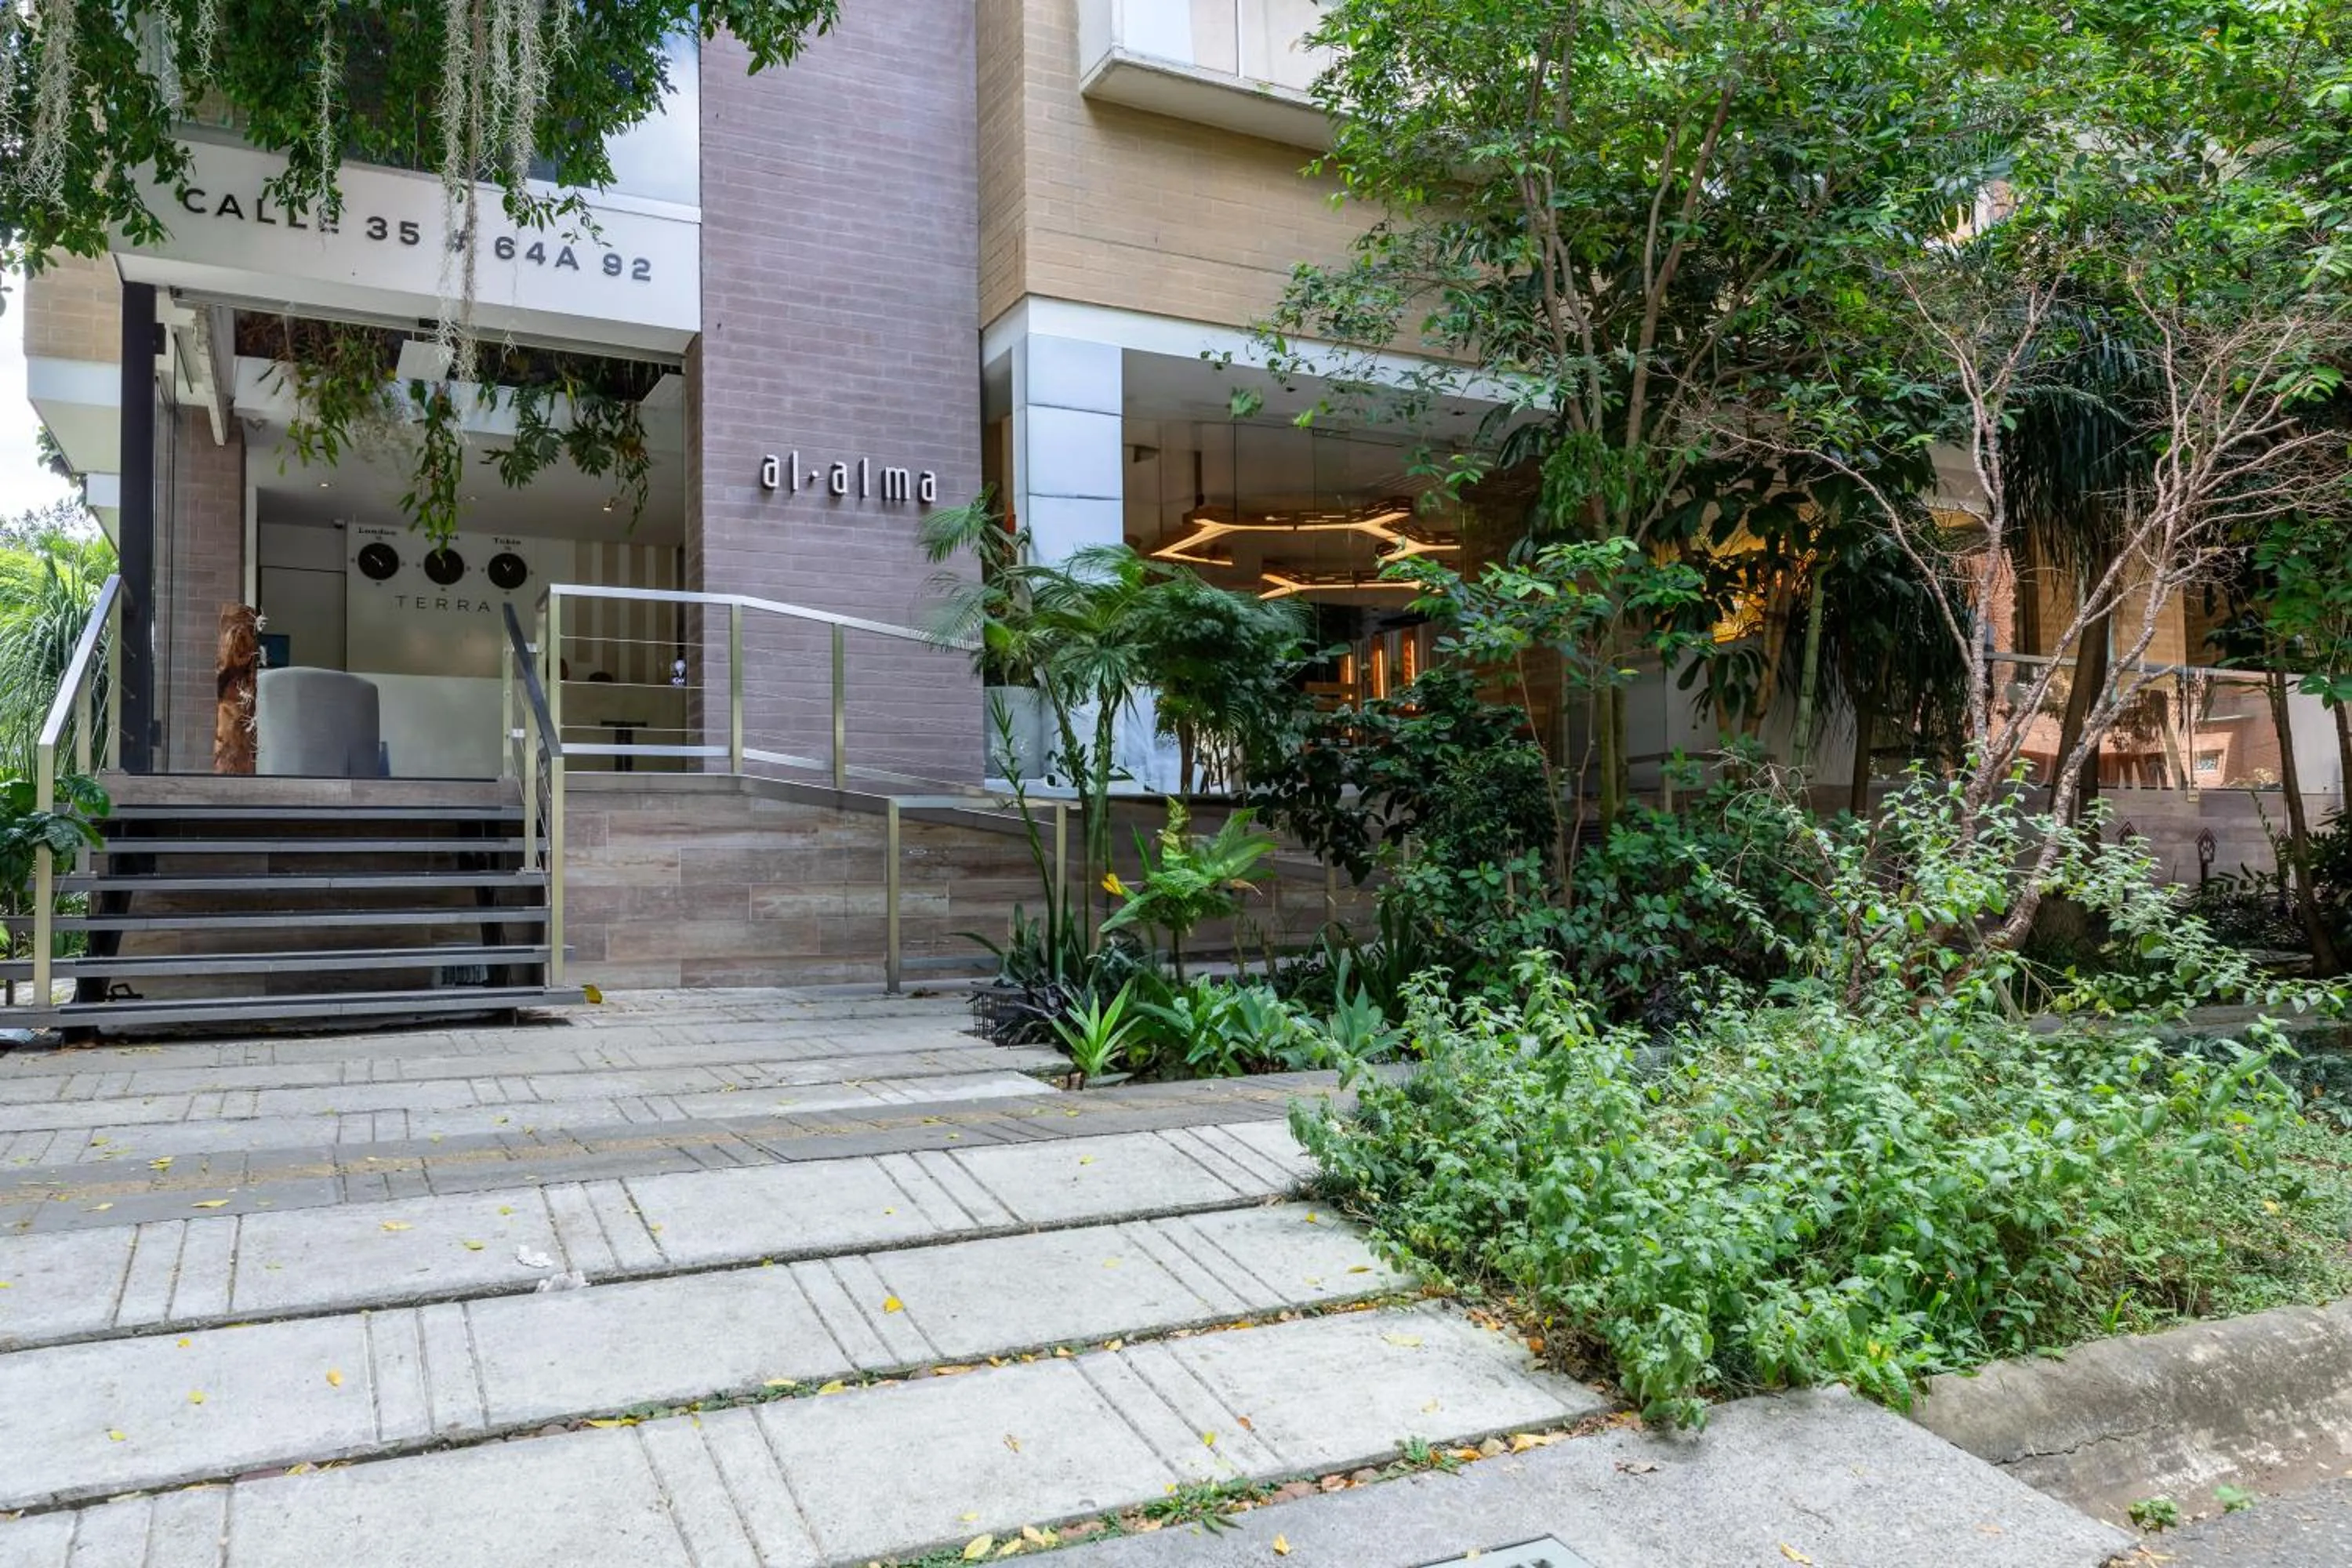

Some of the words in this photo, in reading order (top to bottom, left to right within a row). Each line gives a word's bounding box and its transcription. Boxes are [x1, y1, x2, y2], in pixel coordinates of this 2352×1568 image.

[366, 216, 420, 245] 35
[495, 237, 579, 271] 64A
[603, 252, 652, 282] 92
[395, 595, 490, 612] TERRA
